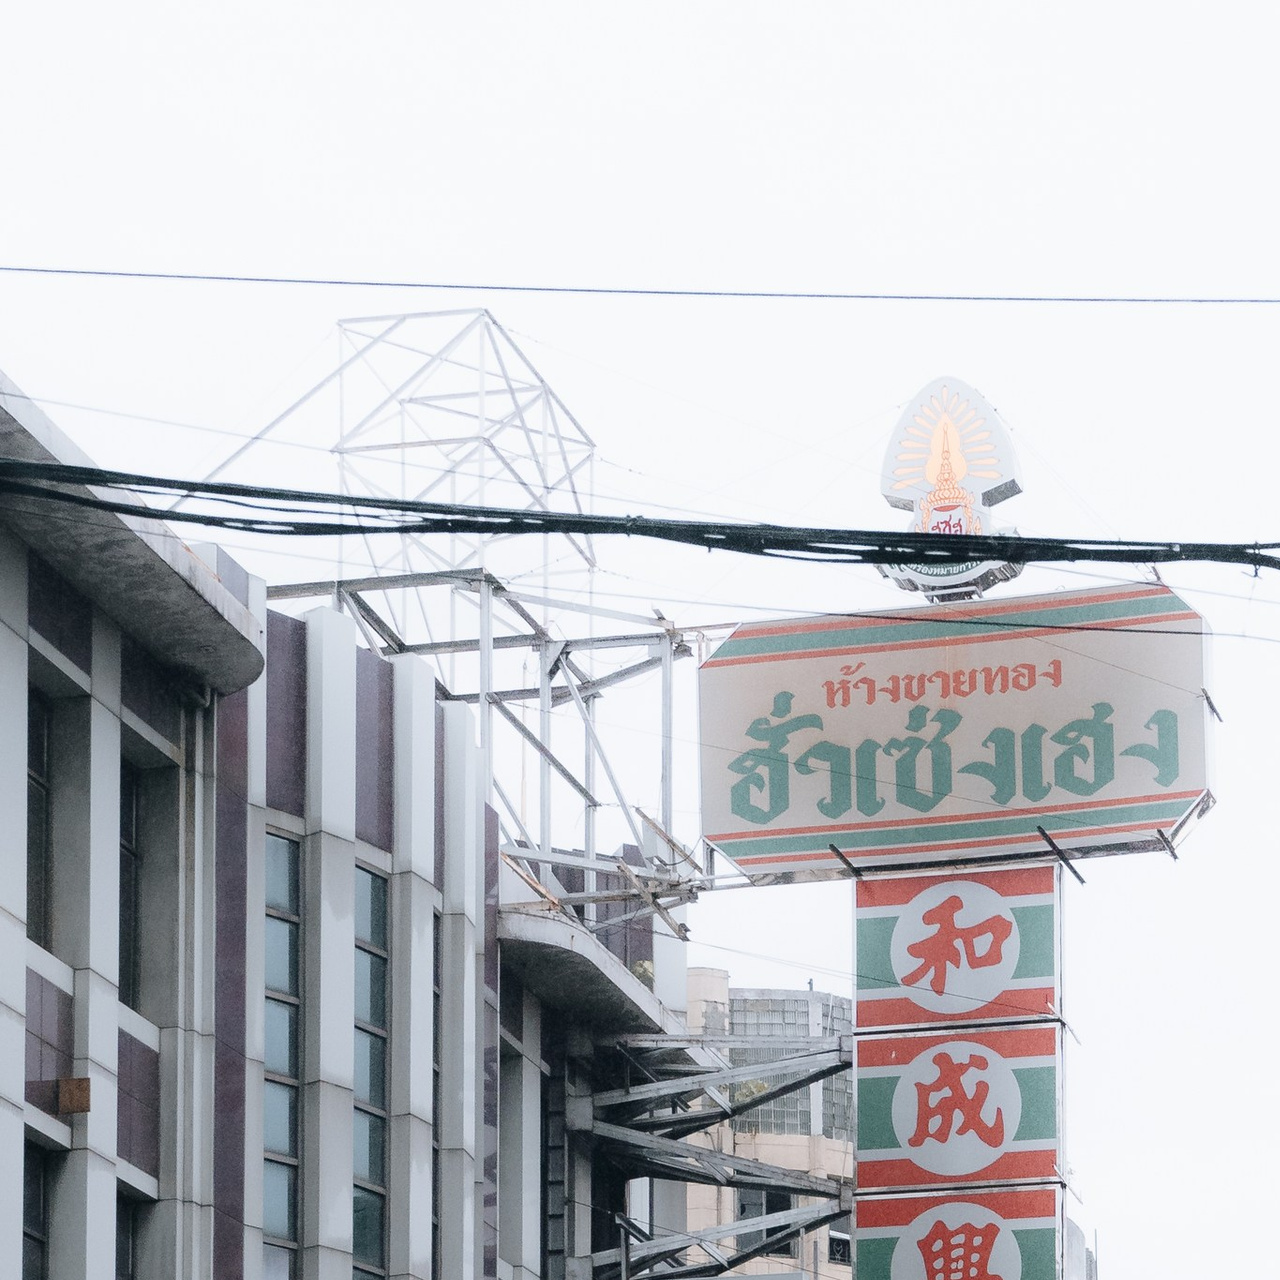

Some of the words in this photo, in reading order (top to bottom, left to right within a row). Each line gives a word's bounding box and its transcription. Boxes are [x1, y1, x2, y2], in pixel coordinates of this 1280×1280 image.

[822, 658, 1063, 710] ห้างขายทอง
[726, 691, 1180, 825] ฮั่วเซ่งเฮง
